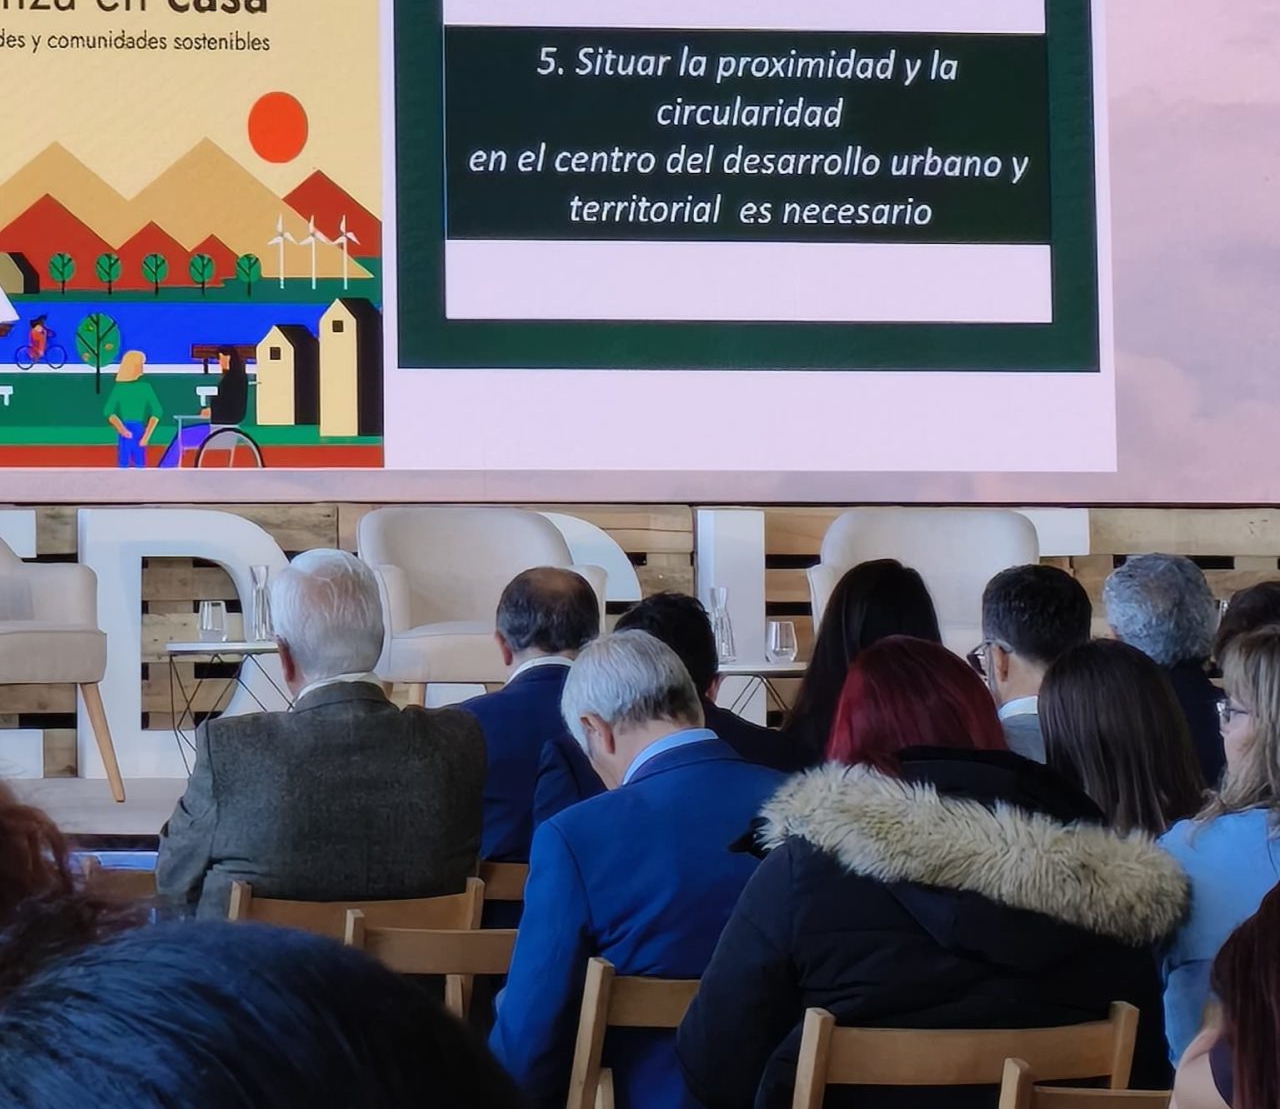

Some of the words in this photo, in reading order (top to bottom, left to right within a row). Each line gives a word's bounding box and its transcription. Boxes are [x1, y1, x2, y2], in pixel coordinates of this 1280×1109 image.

[31, 35, 42, 54] y
[47, 29, 168, 50] comunidades
[173, 30, 271, 51] sostenibles
[536, 47, 564, 75] 5.
[575, 46, 672, 76] Situar
[679, 45, 707, 77] la
[716, 48, 896, 84] proximidad
[904, 58, 922, 86] y
[930, 49, 958, 81] la
[657, 95, 844, 128] circularidad
[469, 150, 507, 172] en
[517, 141, 546, 172] el
[554, 146, 656, 174] centro
[666, 144, 715, 174] del
[723, 144, 881, 176] desarrollo
[891, 146, 1002, 177] urbano
[1012, 156, 1029, 184] y
[569, 193, 722, 224] territorial
[739, 202, 772, 224] es
[782, 197, 932, 225] necesario
